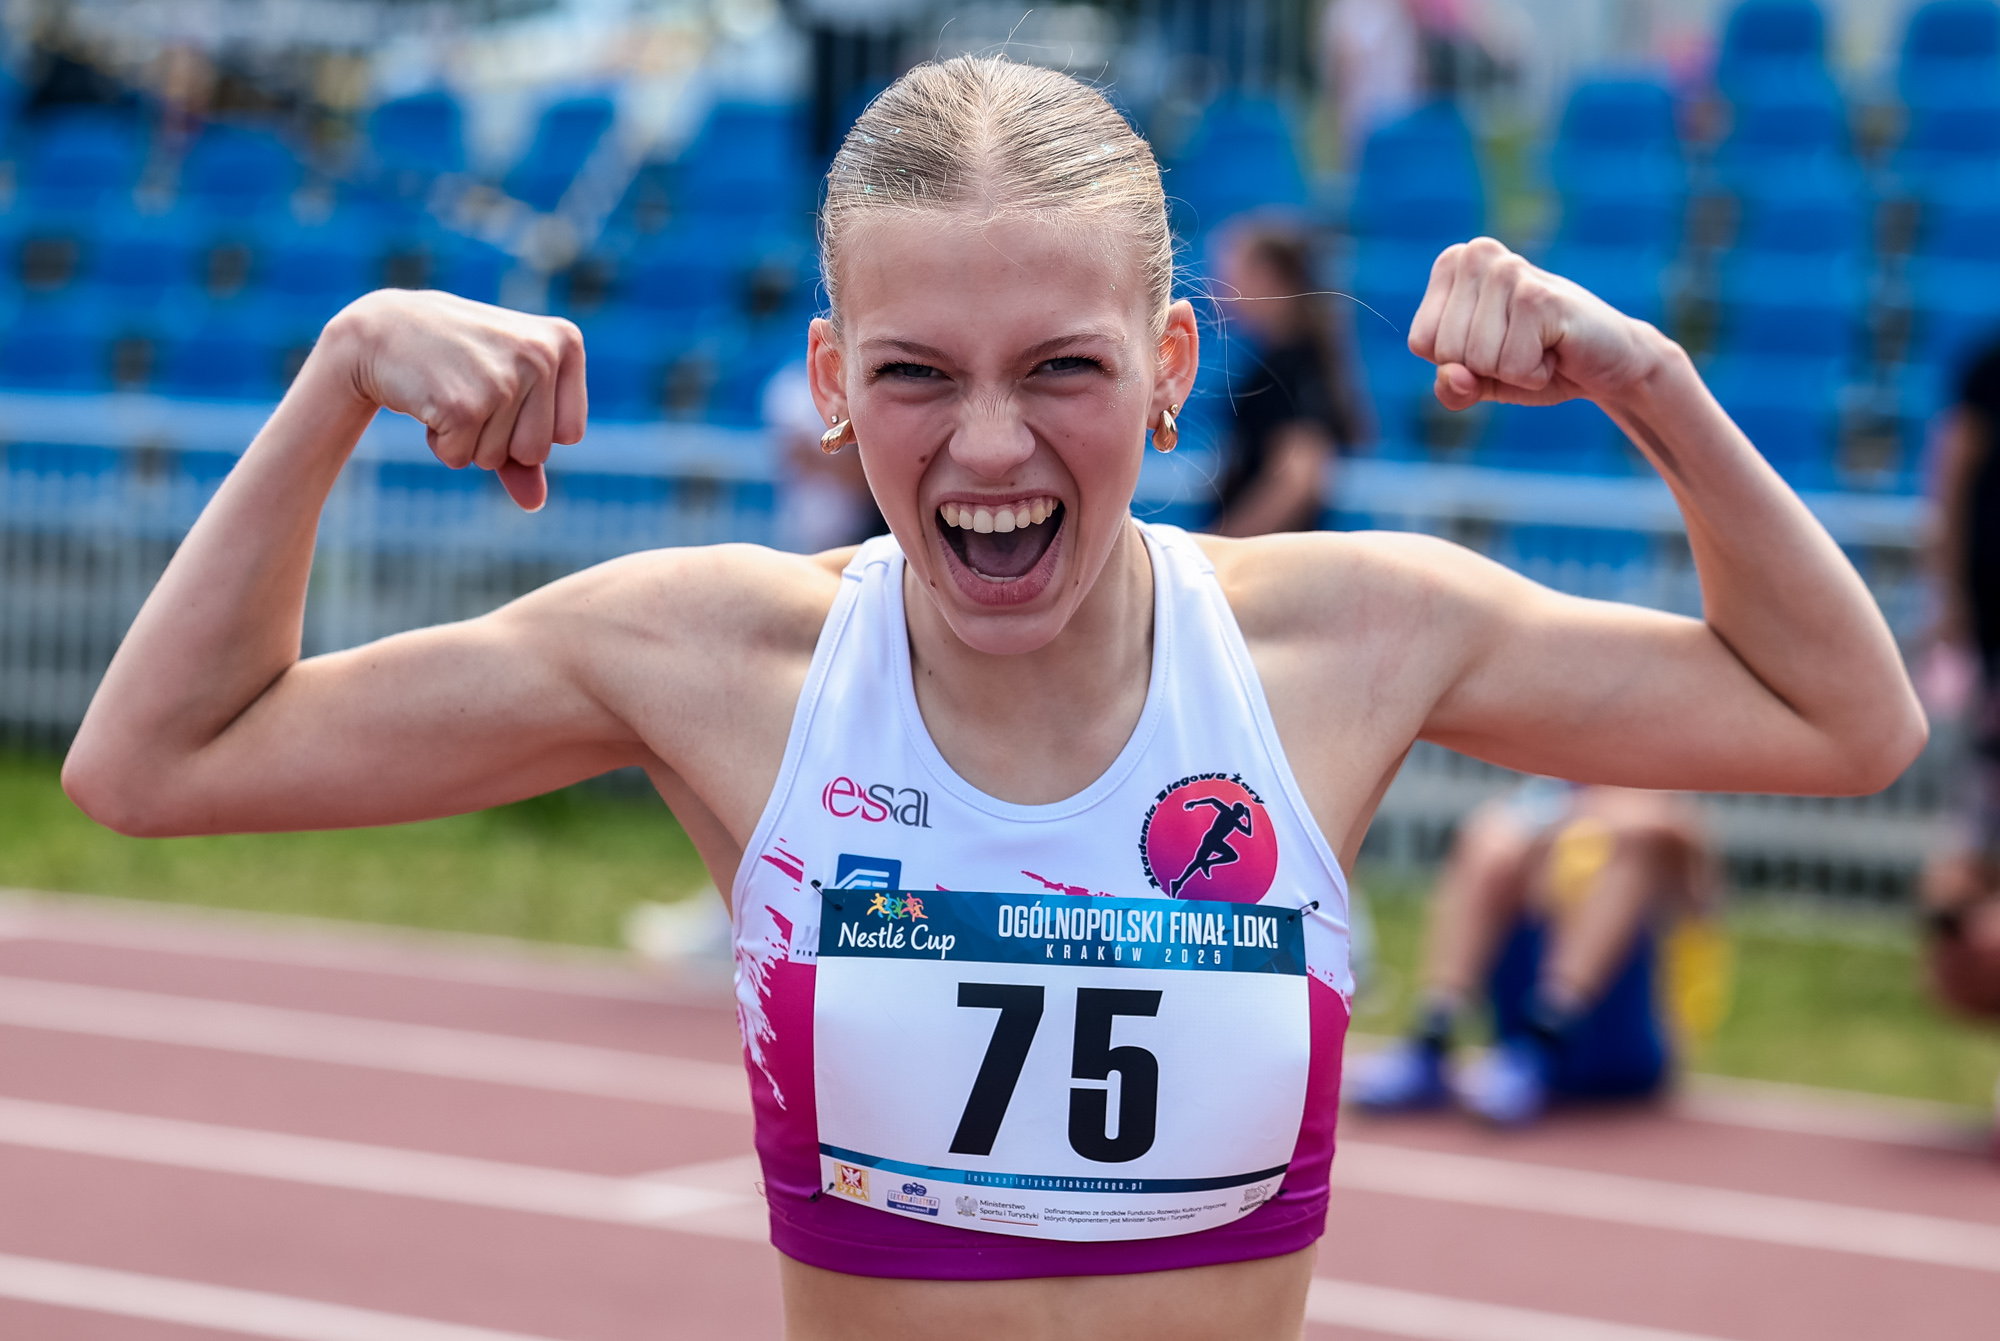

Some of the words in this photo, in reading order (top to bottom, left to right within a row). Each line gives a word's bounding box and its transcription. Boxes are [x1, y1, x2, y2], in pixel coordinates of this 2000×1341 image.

[998, 901, 1163, 943] OGÓLNOPOLSKI
[1170, 911, 1228, 946] FINAŁ
[1233, 913, 1279, 949] LDK!
[838, 921, 906, 949] Nestlé
[910, 924, 956, 960] Cup
[1046, 943, 1142, 962] KRAKÓW
[1165, 948, 1221, 965] 2025
[948, 982, 1164, 1163] 75
[979, 1200, 1026, 1210] Ministerstwo
[979, 1207, 1003, 1218] Sportu
[1007, 1210, 1039, 1220] Turystyki
[1044, 1208, 1091, 1216] Dofinansowano
[1156, 1207, 1181, 1216] Rozwoju
[1044, 1215, 1067, 1223] których
[1067, 1216, 1109, 1224] dysponentem
[1146, 1215, 1166, 1223] Sportu
